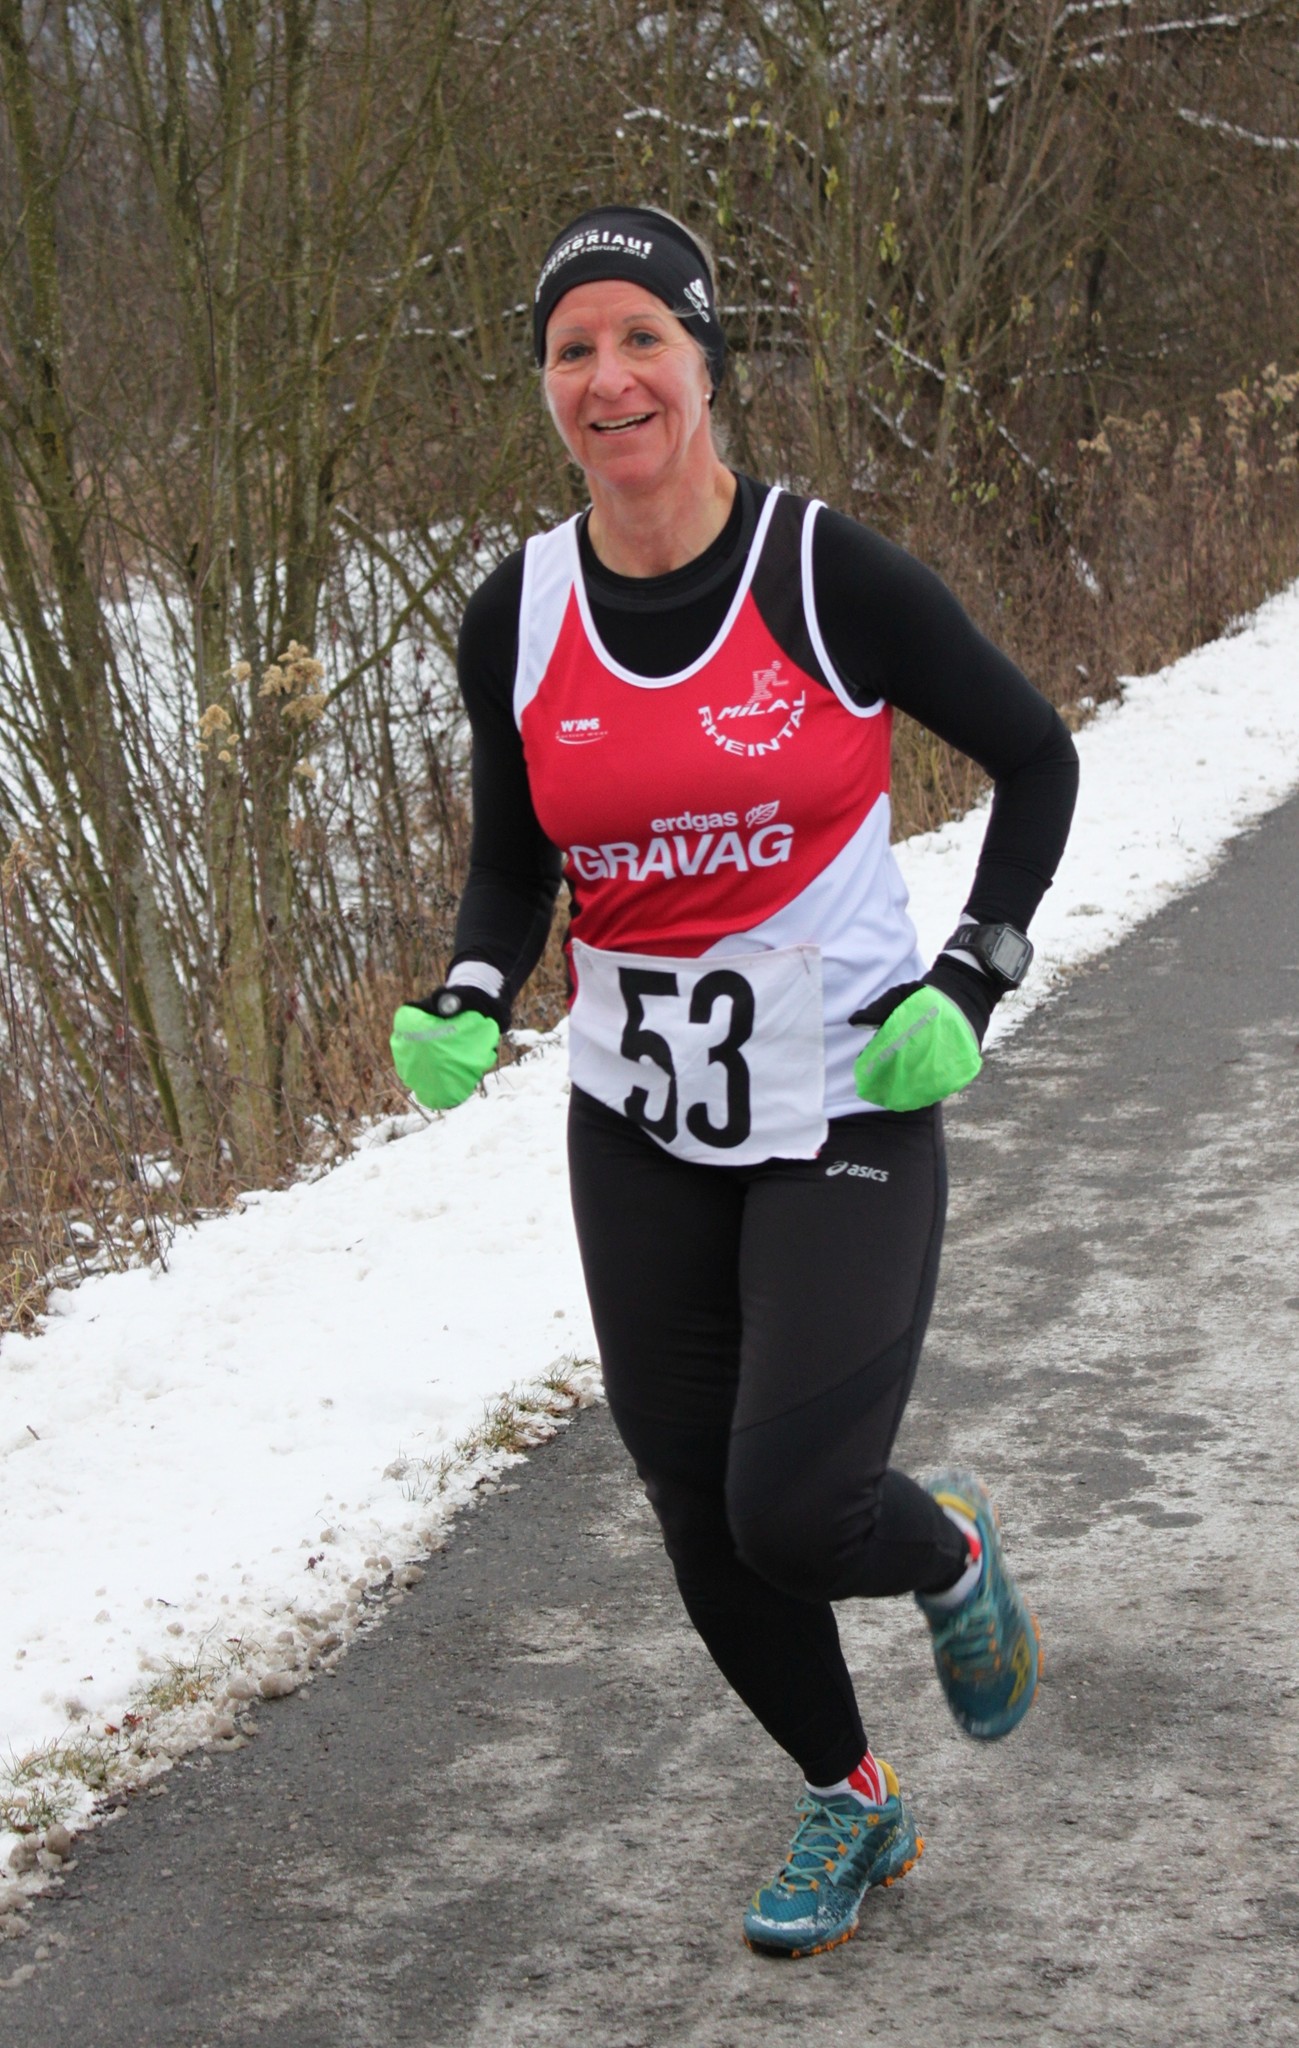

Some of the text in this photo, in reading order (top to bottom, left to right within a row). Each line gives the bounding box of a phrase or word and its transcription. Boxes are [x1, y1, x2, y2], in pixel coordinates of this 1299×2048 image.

[623, 247, 648, 260] 2016
[698, 690, 806, 757] RHEINTAL
[651, 811, 739, 833] erdgas
[569, 823, 795, 882] GRAVAG
[618, 967, 756, 1149] 53
[846, 1163, 890, 1183] asics
